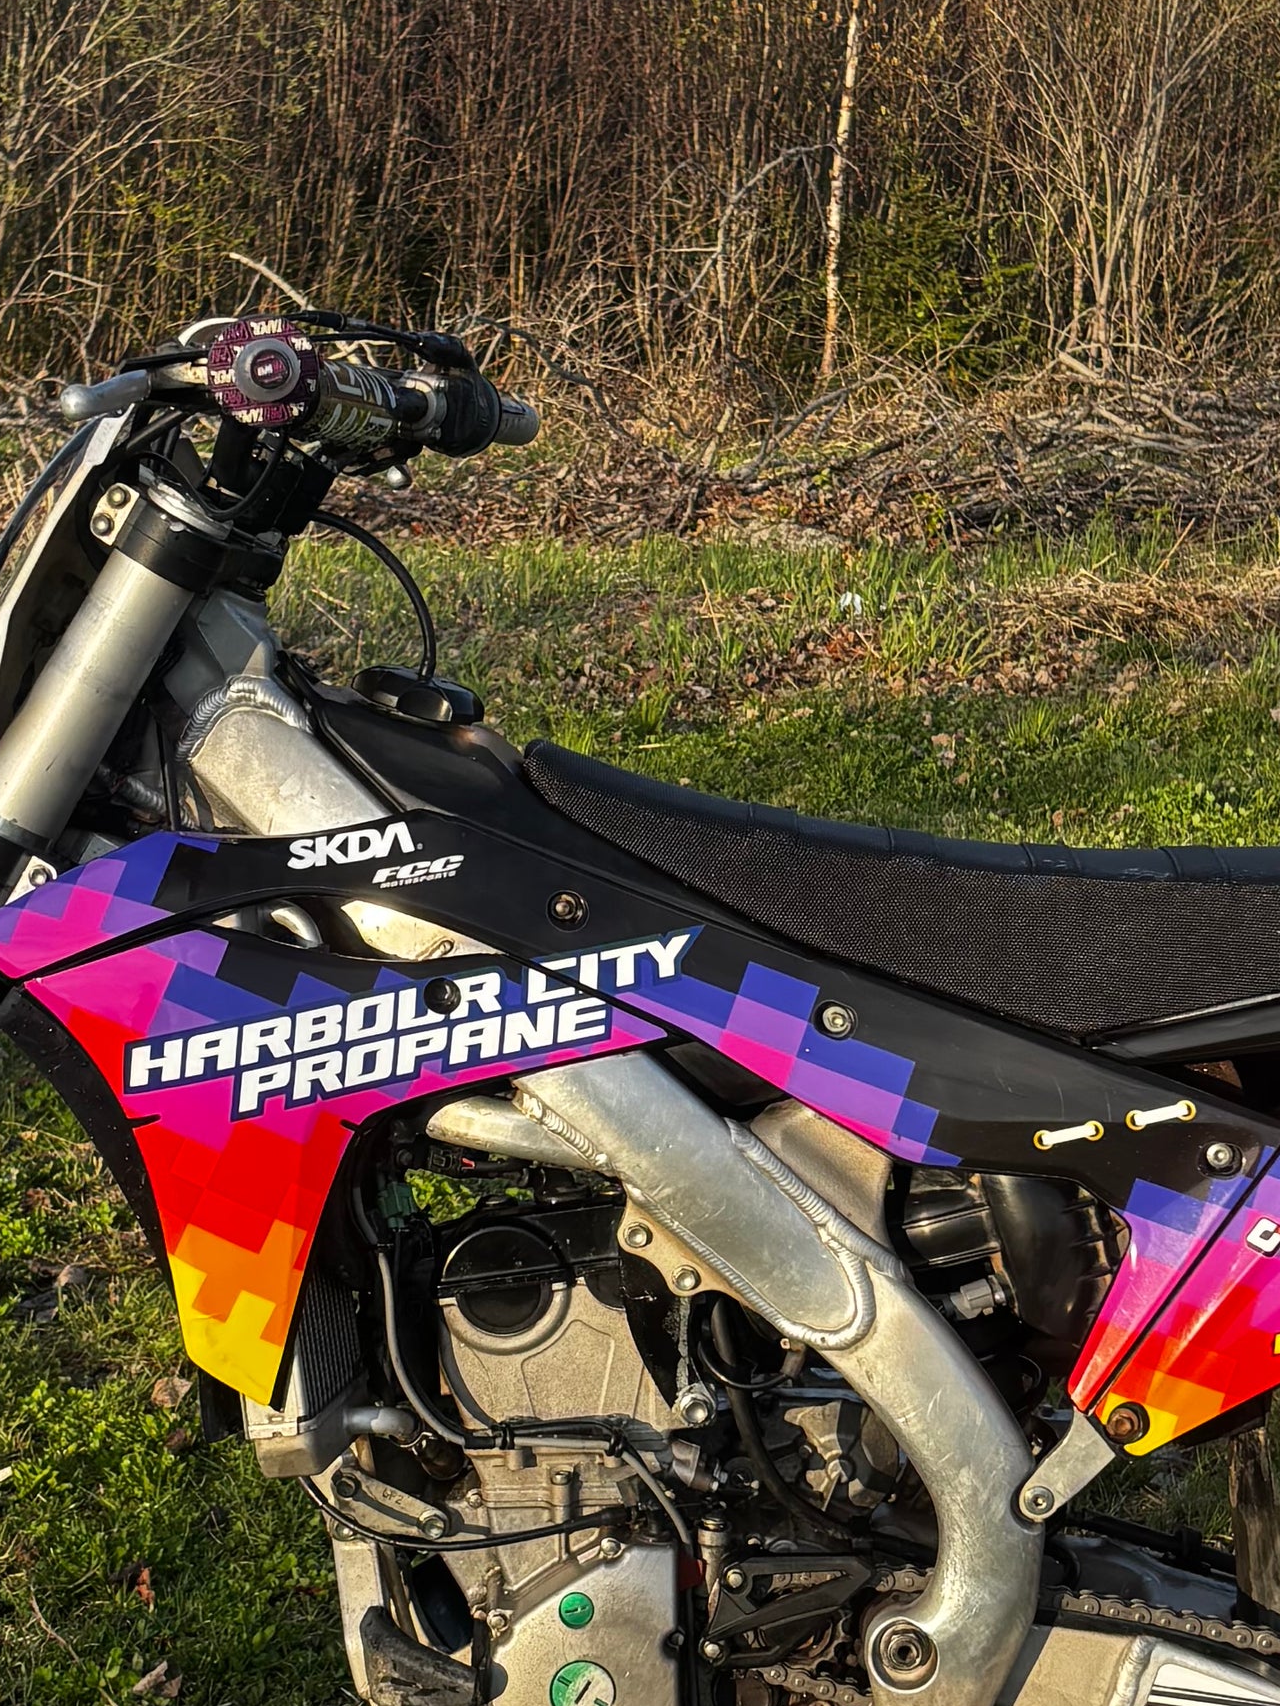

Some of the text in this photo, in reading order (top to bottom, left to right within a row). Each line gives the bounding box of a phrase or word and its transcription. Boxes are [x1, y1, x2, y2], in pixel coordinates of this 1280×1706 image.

[287, 821, 416, 870] SKDA
[372, 854, 465, 884] FCC
[129, 934, 691, 1088] HARBOUR CITY
[238, 997, 607, 1113] PROPANE
